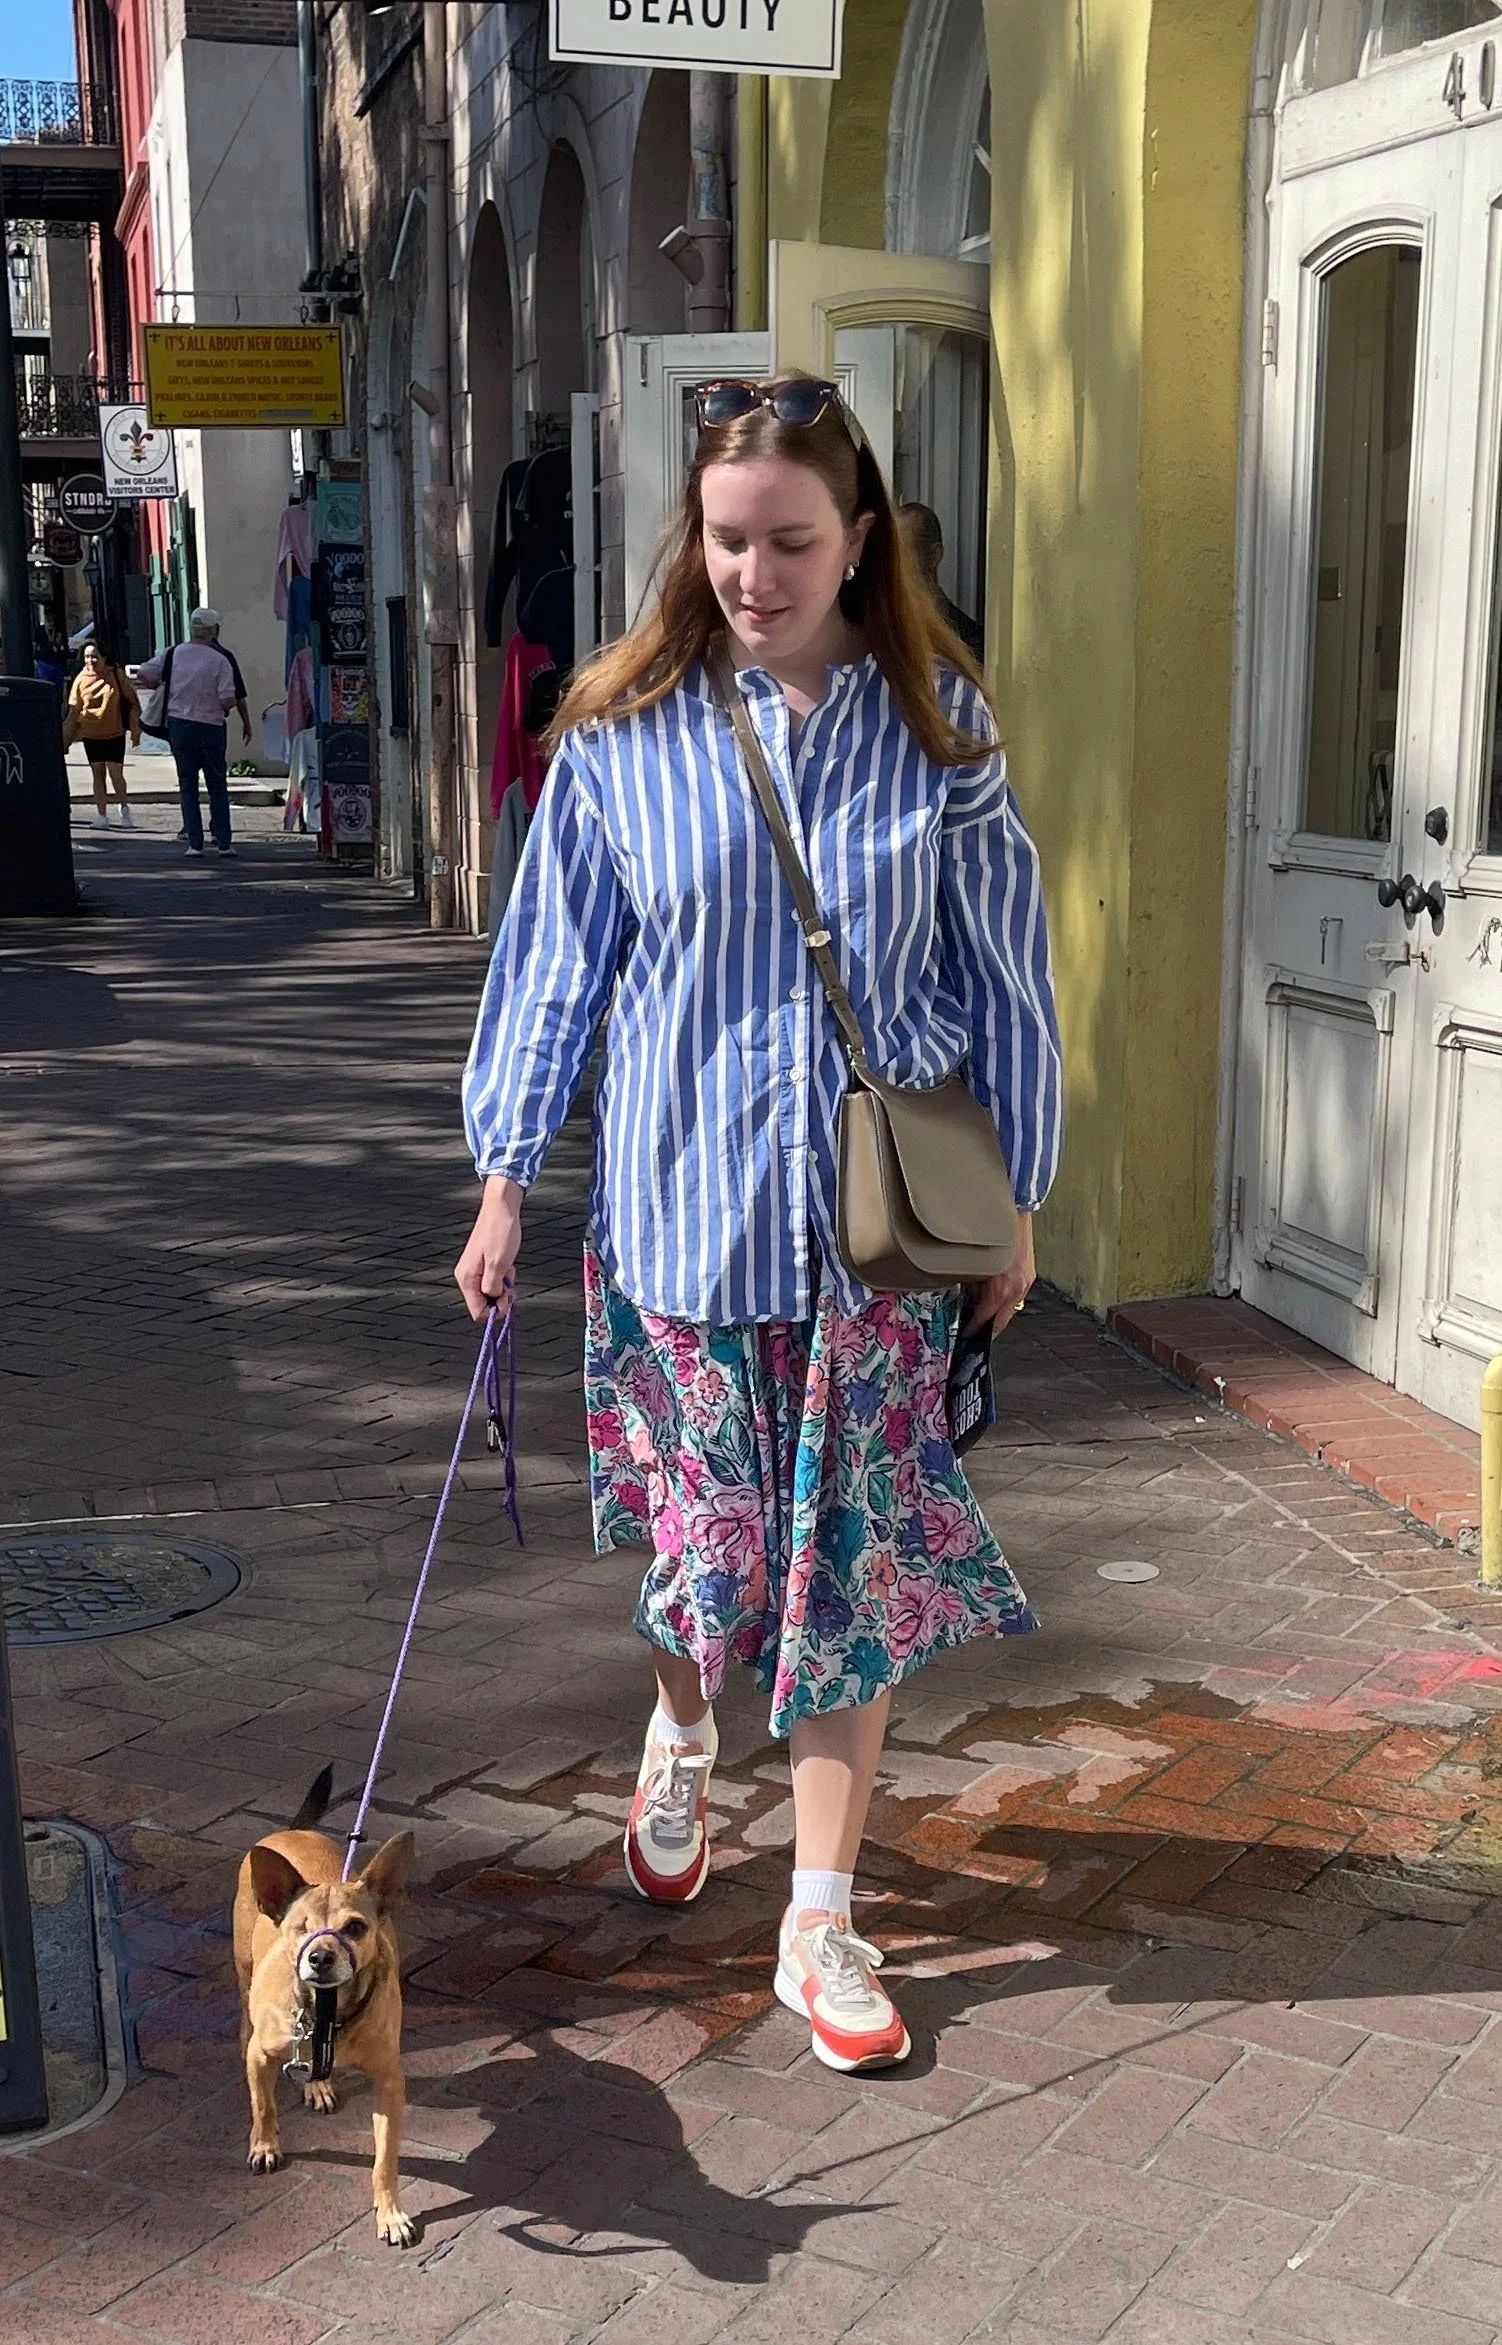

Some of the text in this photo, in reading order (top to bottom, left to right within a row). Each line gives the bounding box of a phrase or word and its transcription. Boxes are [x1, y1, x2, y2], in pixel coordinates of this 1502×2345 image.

[165, 335, 323, 351] IT'S ALL ABOUT NEW ORLEANS
[176, 359, 194, 369] NEW
[195, 359, 228, 369] ORLEANS
[114, 477, 168, 485] NEW ORLEANS
[108, 486, 175, 495] VISITORS CENTER
[324, 552, 365, 567] VOODO
